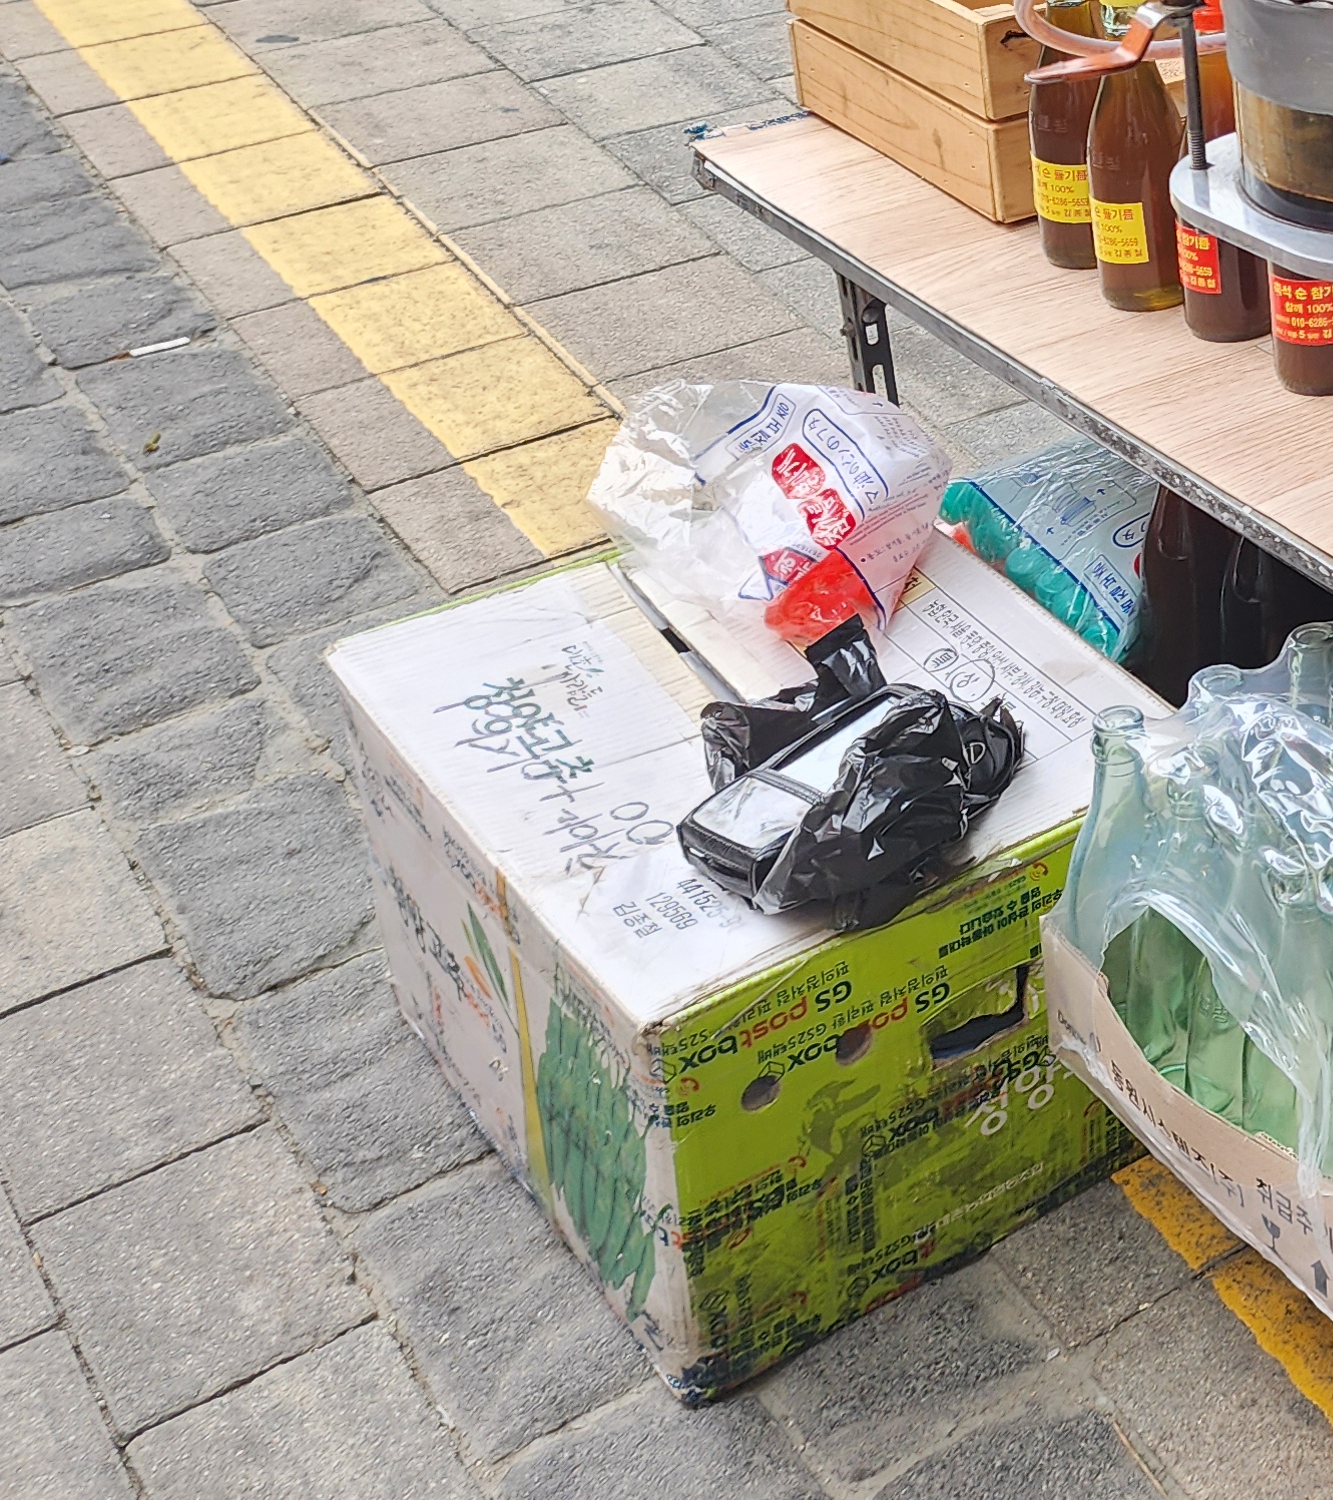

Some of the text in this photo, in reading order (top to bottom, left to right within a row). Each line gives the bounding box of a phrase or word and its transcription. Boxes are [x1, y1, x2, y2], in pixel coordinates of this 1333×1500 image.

[1042, 168, 1087, 181] 순 들기름
[1051, 184, 1074, 194] 100%
[1102, 208, 1134, 220] 들기름
[1295, 287, 1307, 300] 순
[612, 901, 663, 940] 김종철
[645, 891, 699, 931] 129569
[831, 964, 949, 1028] 편의점처럼 편리한
[916, 982, 952, 1015] GS
[679, 979, 853, 1073] GS postbox
[757, 1021, 828, 1065] GS25택배
